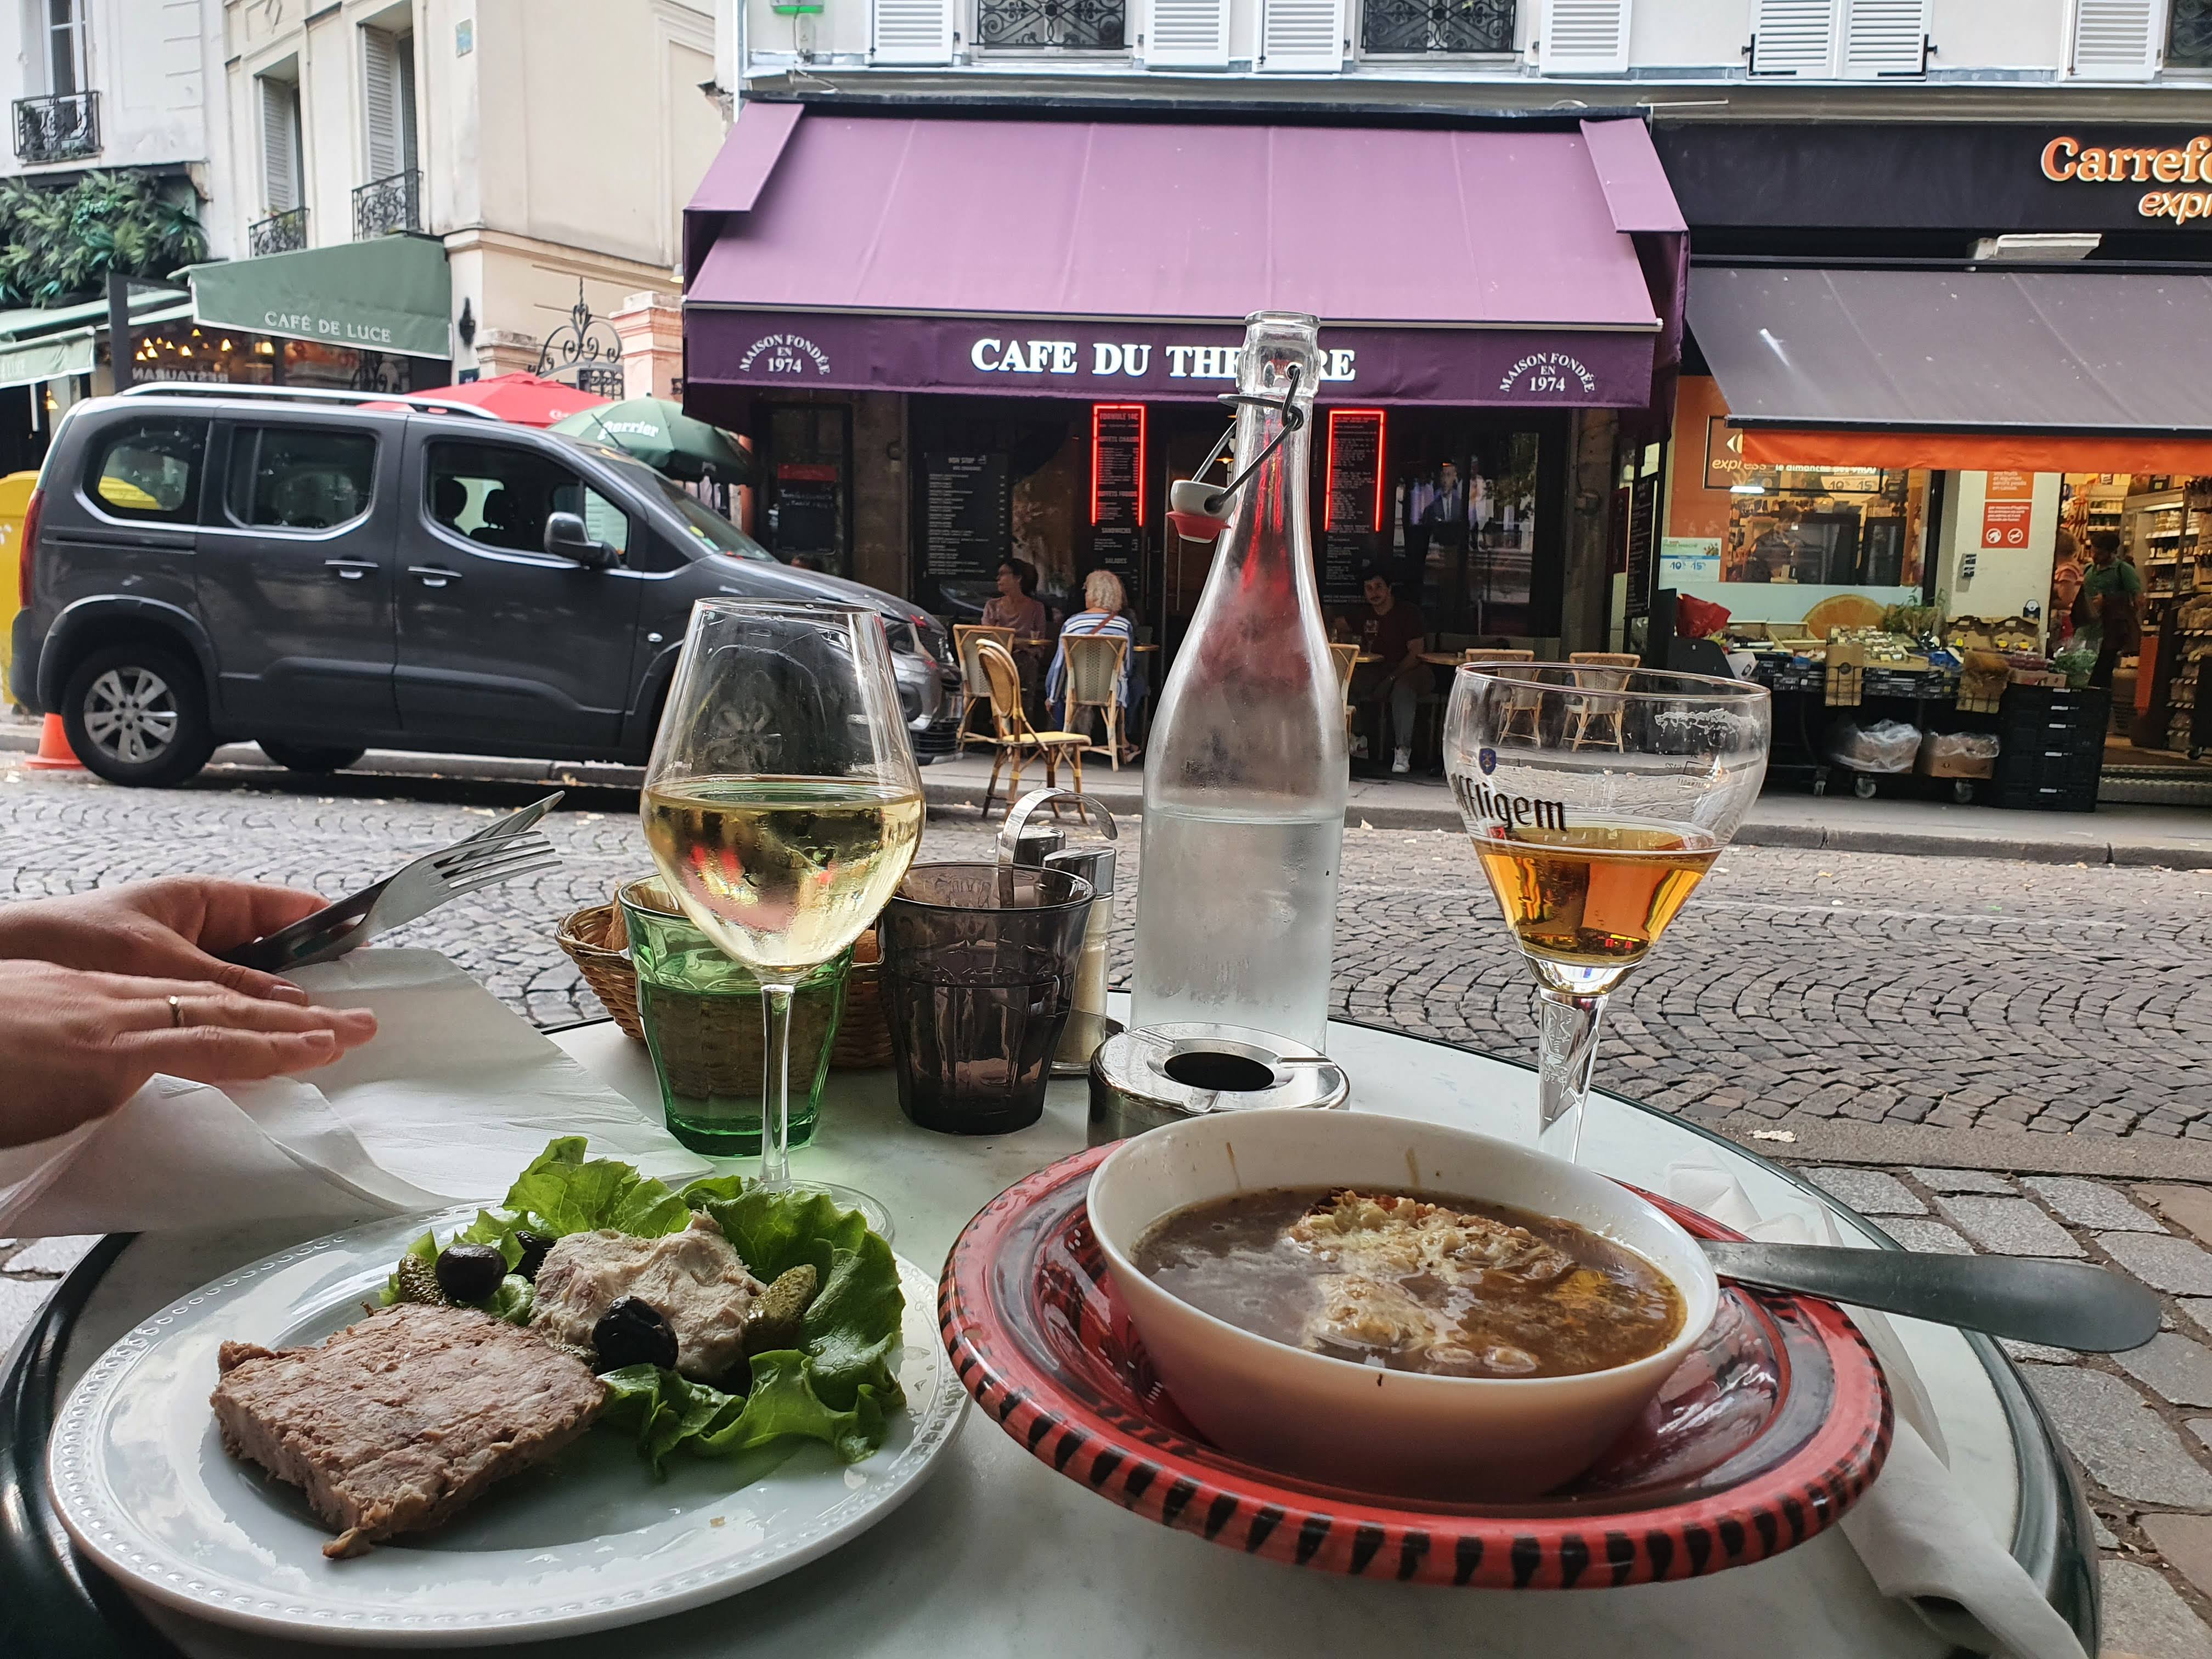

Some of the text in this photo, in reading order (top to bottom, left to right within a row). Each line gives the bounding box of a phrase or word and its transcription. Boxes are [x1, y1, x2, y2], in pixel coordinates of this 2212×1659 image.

[318, 319, 341, 336] DE
[347, 323, 392, 343] LUCE
[739, 334, 831, 375] MAISON FONDÉE
[777, 346, 792, 357] EN
[971, 338, 1077, 374] CAFE
[1092, 343, 1152, 377] DU
[768, 357, 802, 374] 1974
[1499, 352, 1595, 393] MAISON FONDÉE
[1541, 365, 1556, 375] EN
[1530, 376, 1566, 392] 1974
